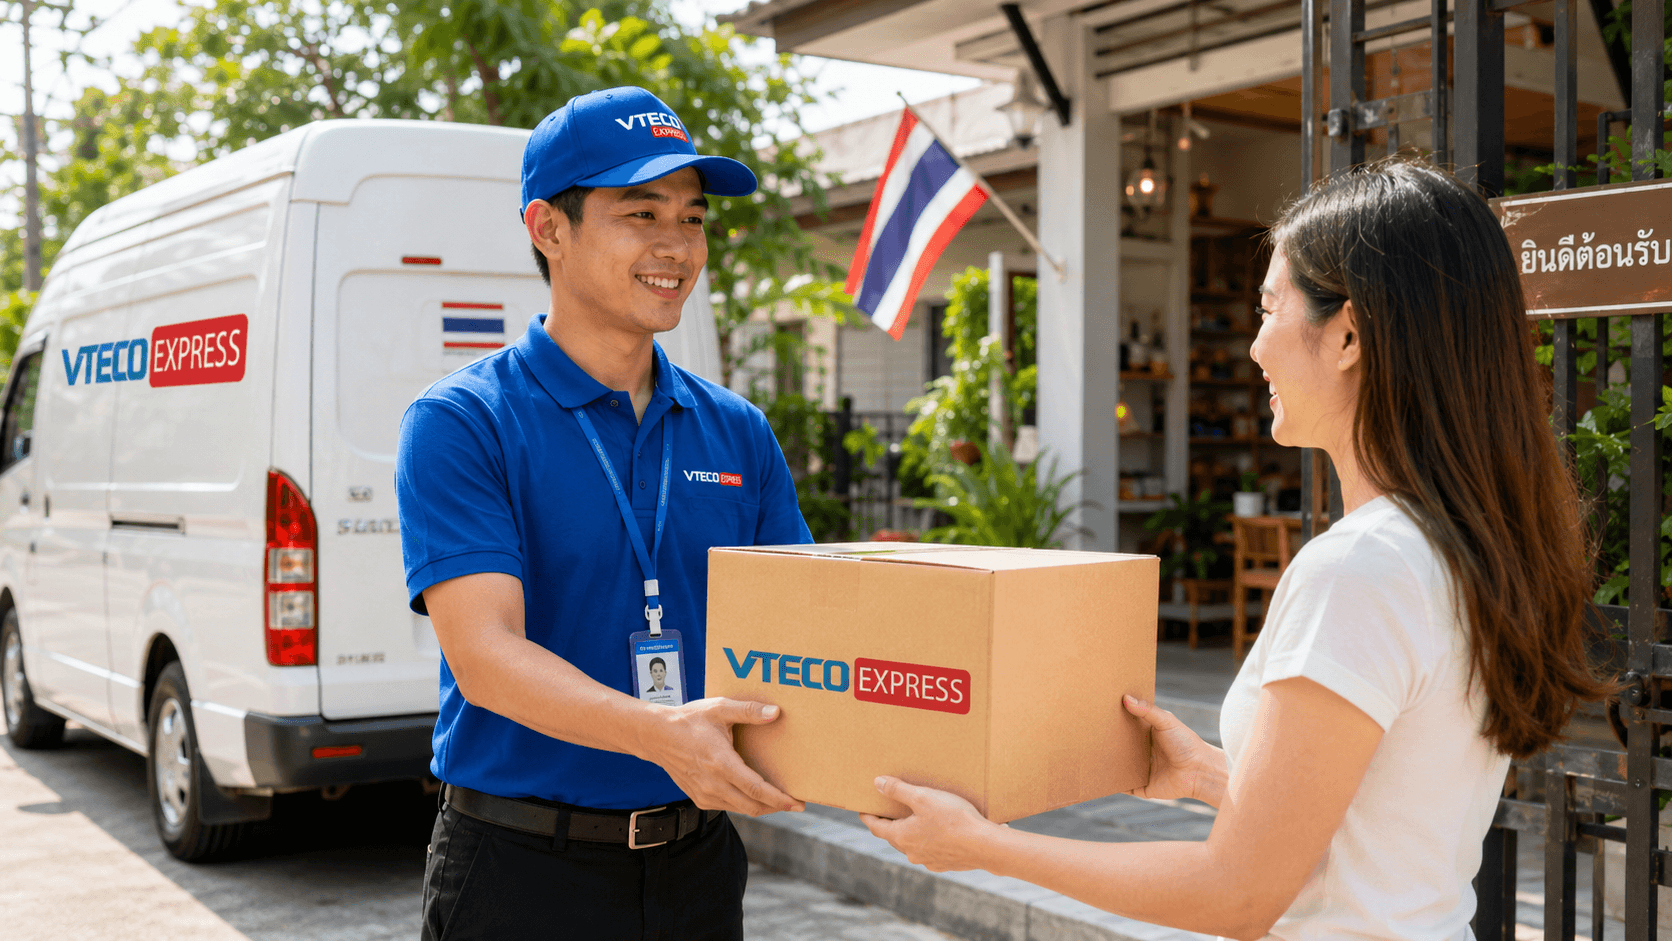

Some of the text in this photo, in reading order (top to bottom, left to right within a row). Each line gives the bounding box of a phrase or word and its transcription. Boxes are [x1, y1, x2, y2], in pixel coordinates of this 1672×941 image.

[614, 112, 681, 130] VTECO
[1520, 228, 1671, 274] ยินดีต้อนรับ
[61, 329, 241, 386] VTECO EXPRESS
[683, 469, 720, 483] VTECO
[722, 647, 964, 704] VTECO EXPRESS
